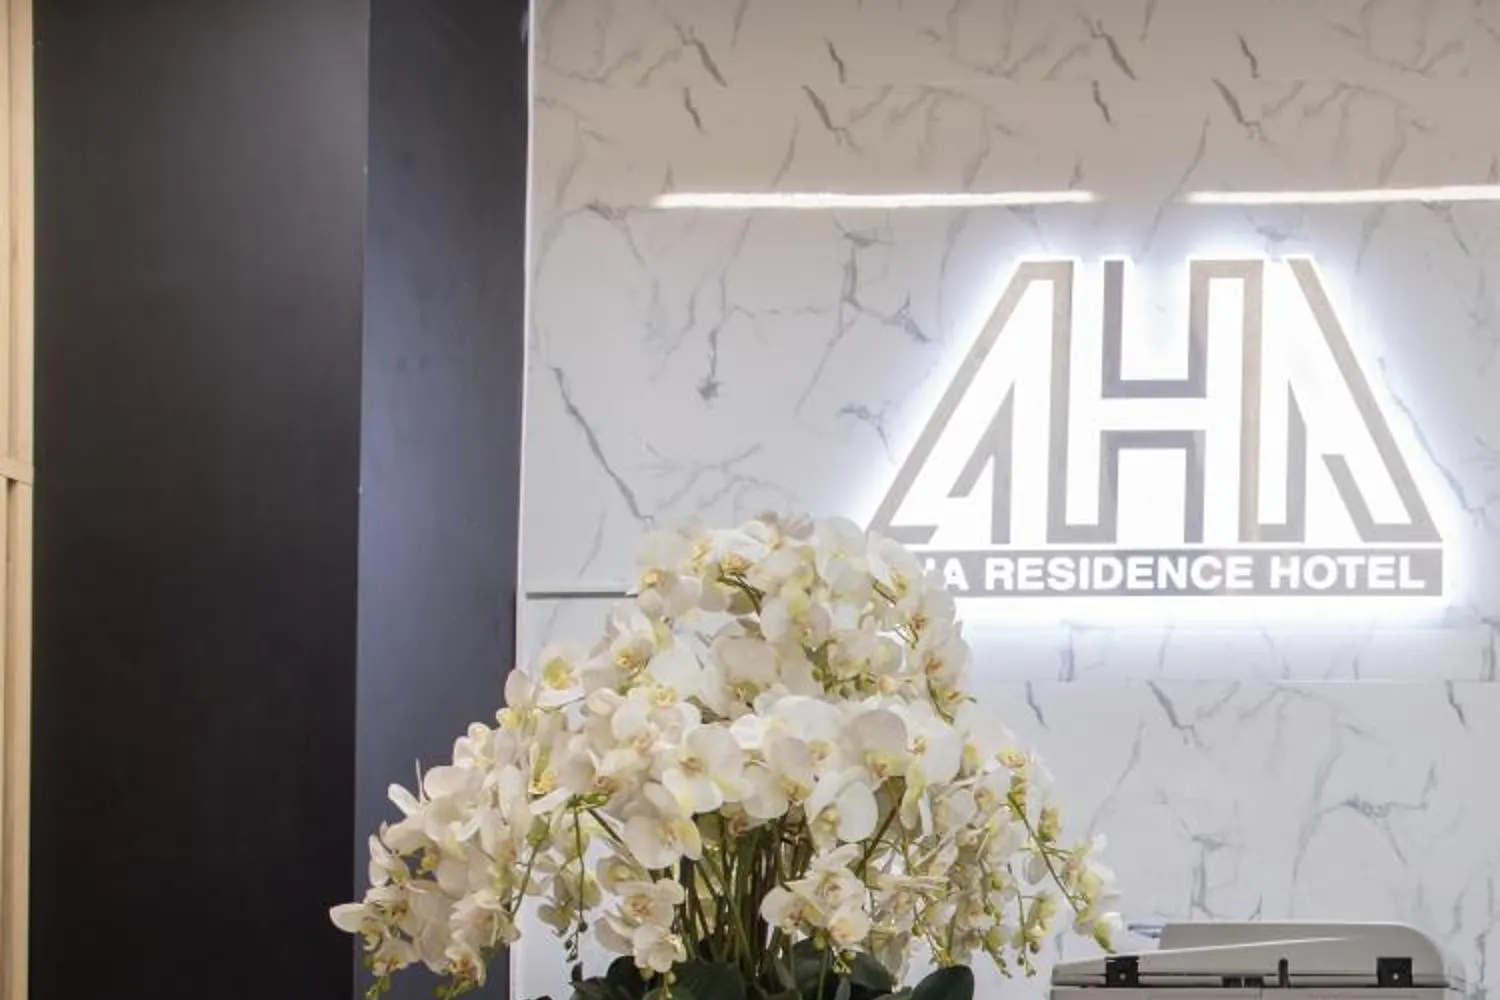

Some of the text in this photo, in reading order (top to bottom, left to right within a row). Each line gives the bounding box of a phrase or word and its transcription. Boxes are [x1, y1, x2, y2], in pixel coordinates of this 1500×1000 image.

[865, 258, 1443, 544] AHA
[985, 556, 1253, 590] RESIDENCE
[1269, 556, 1425, 589] HOTEL
